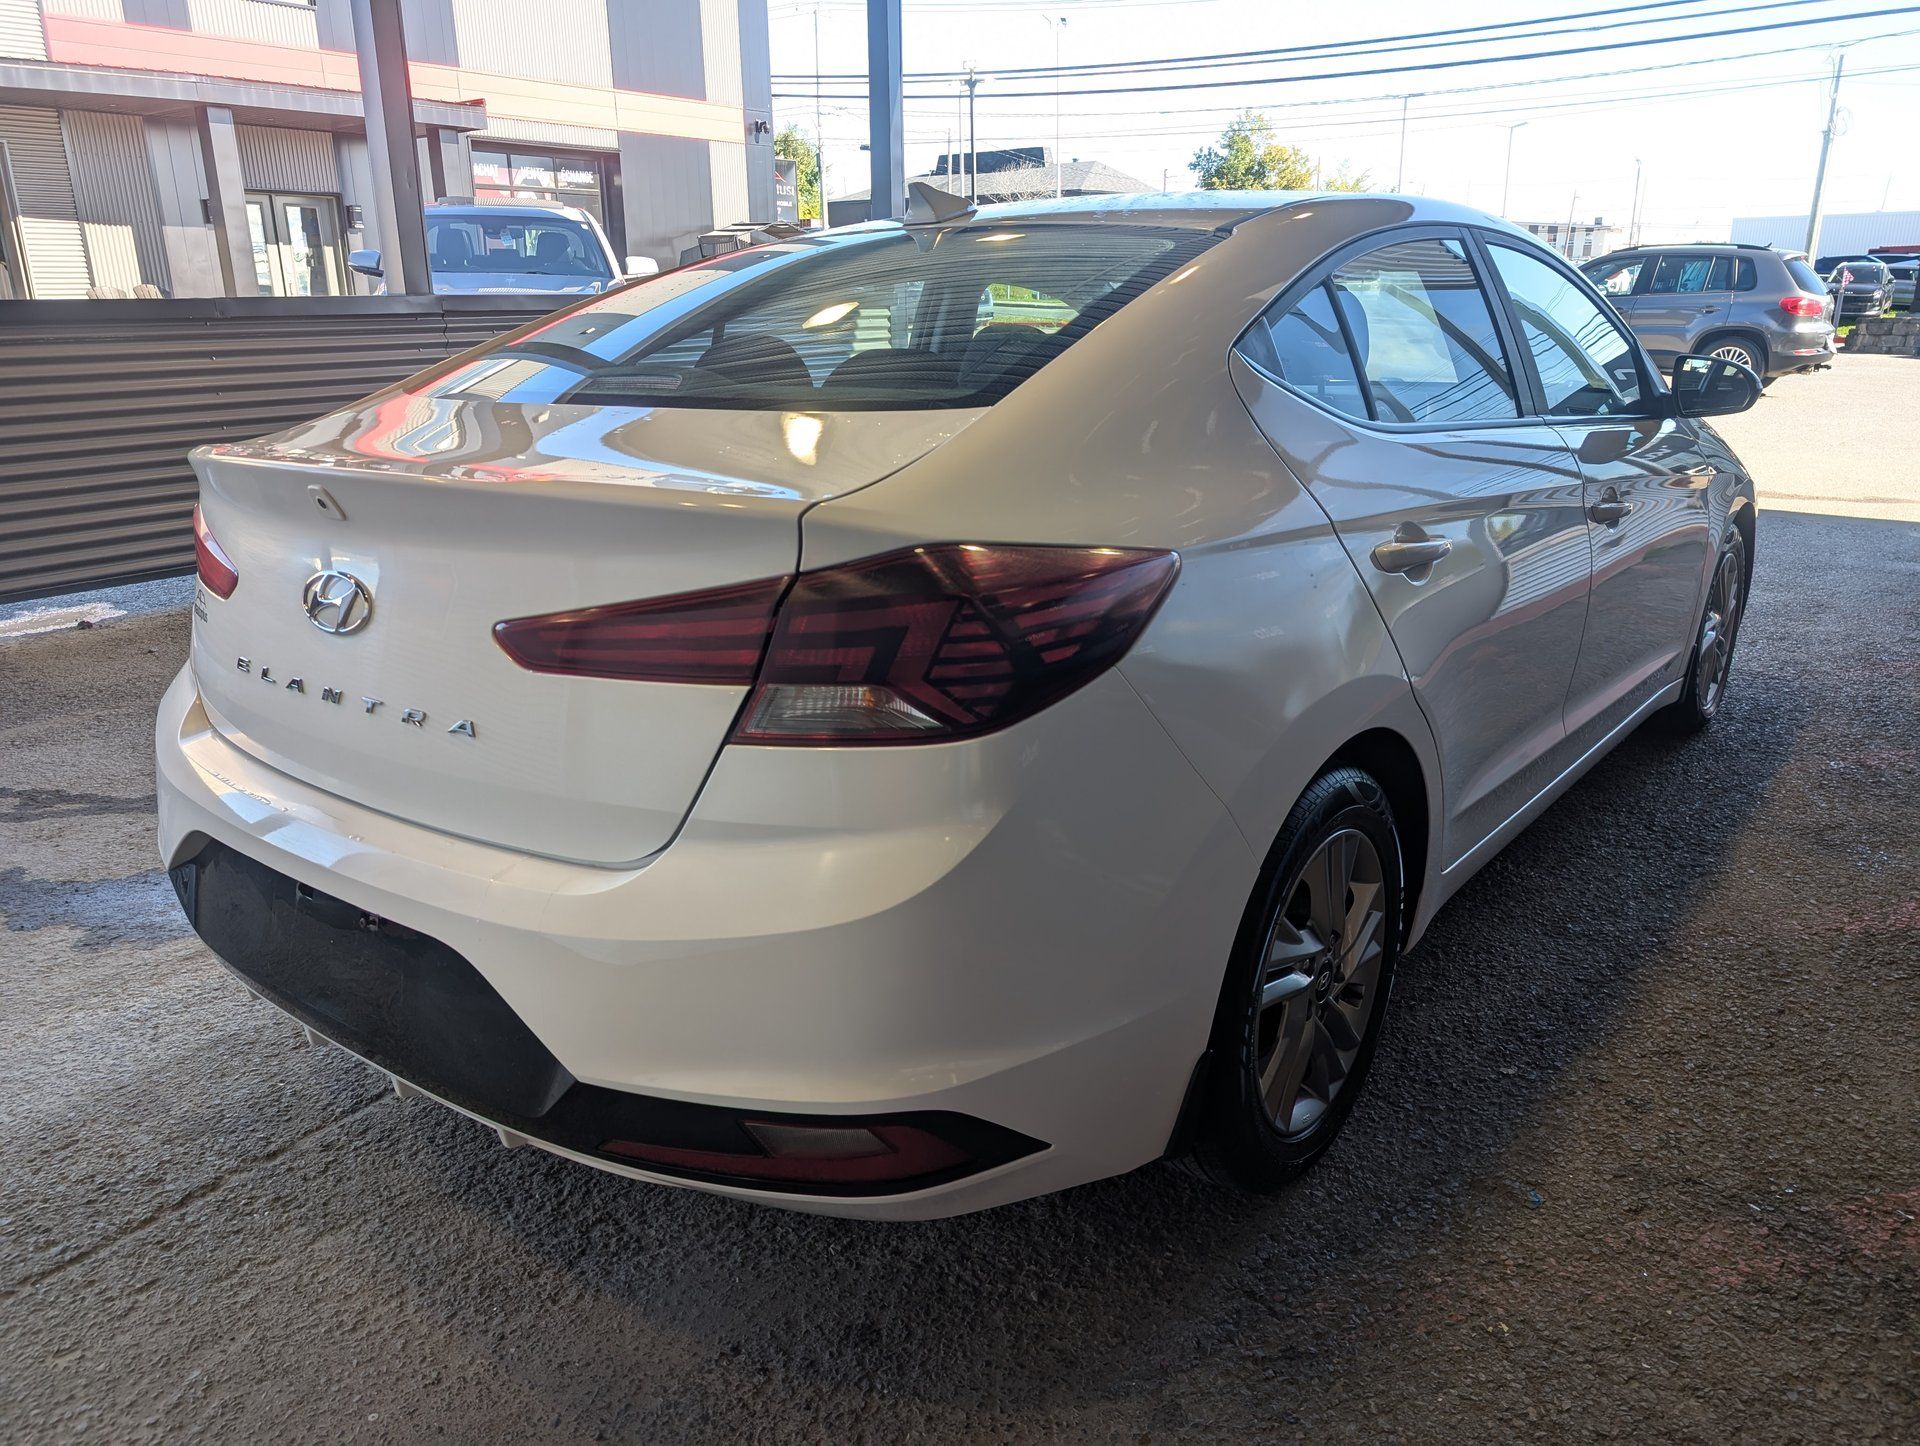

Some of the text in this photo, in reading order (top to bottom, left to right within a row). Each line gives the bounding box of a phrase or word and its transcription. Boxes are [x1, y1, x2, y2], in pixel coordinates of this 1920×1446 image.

[473, 162, 594, 184] ACHAT VENTE ÉCHANGE
[236, 656, 477, 738] ELANTRA
